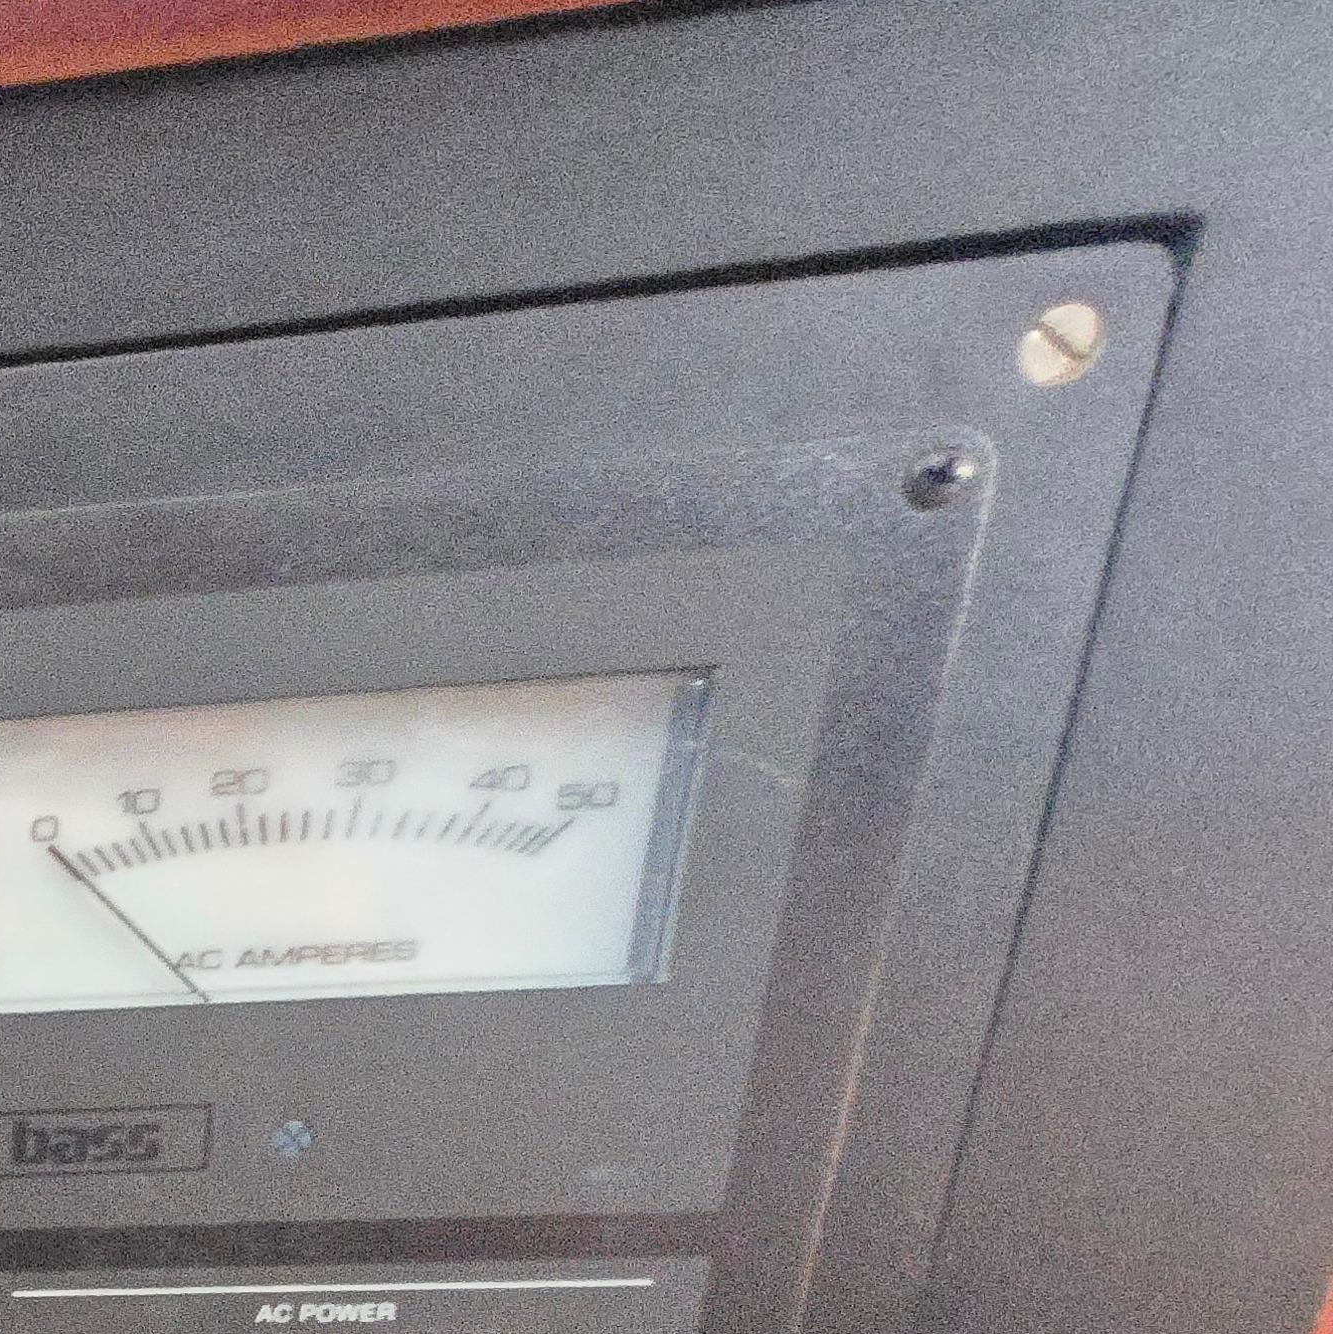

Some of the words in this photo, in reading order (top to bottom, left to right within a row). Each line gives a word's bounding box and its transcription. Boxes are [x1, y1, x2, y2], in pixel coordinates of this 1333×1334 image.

[210, 766, 271, 797] 20
[336, 758, 396, 789] 30
[469, 762, 531, 793] 40
[116, 786, 163, 816] 10
[556, 781, 619, 812] 50
[32, 814, 60, 844] 0
[175, 945, 223, 972] AC
[234, 938, 421, 970] AMPERES
[11, 1119, 162, 1166] bass
[254, 1304, 297, 1324] AC
[299, 1302, 397, 1323] POWER
